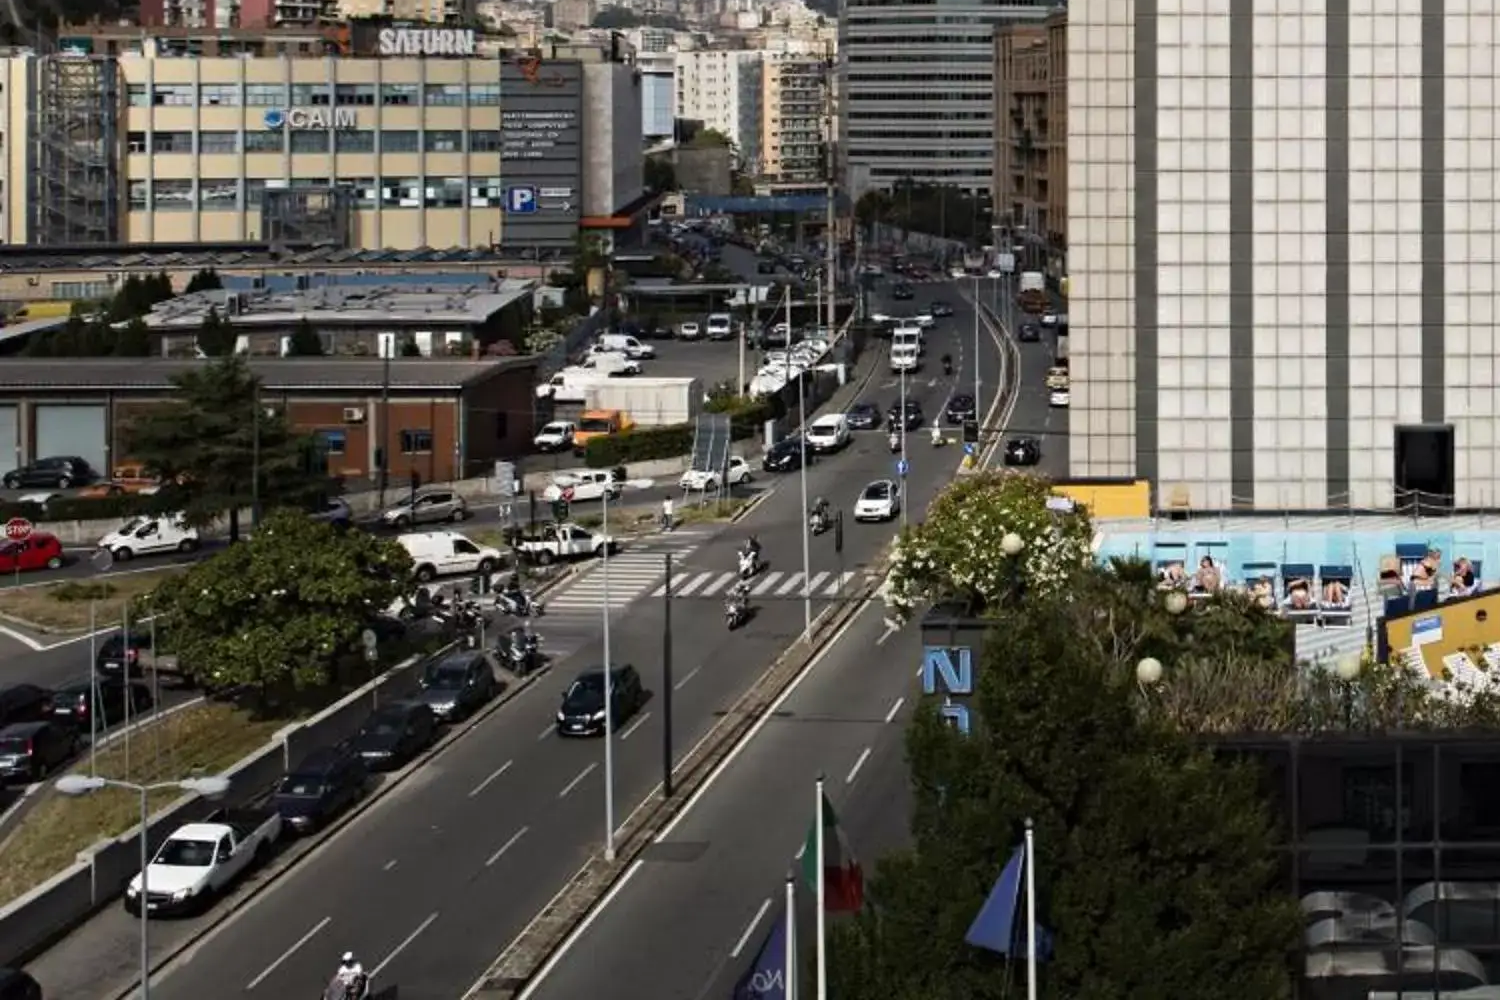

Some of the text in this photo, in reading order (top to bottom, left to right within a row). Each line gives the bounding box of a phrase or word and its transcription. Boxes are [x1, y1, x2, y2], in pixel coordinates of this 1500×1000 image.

[379, 28, 475, 55] SATURN
[289, 107, 358, 128] CAIM
[513, 188, 533, 211] P
[7, 525, 30, 536] STOP
